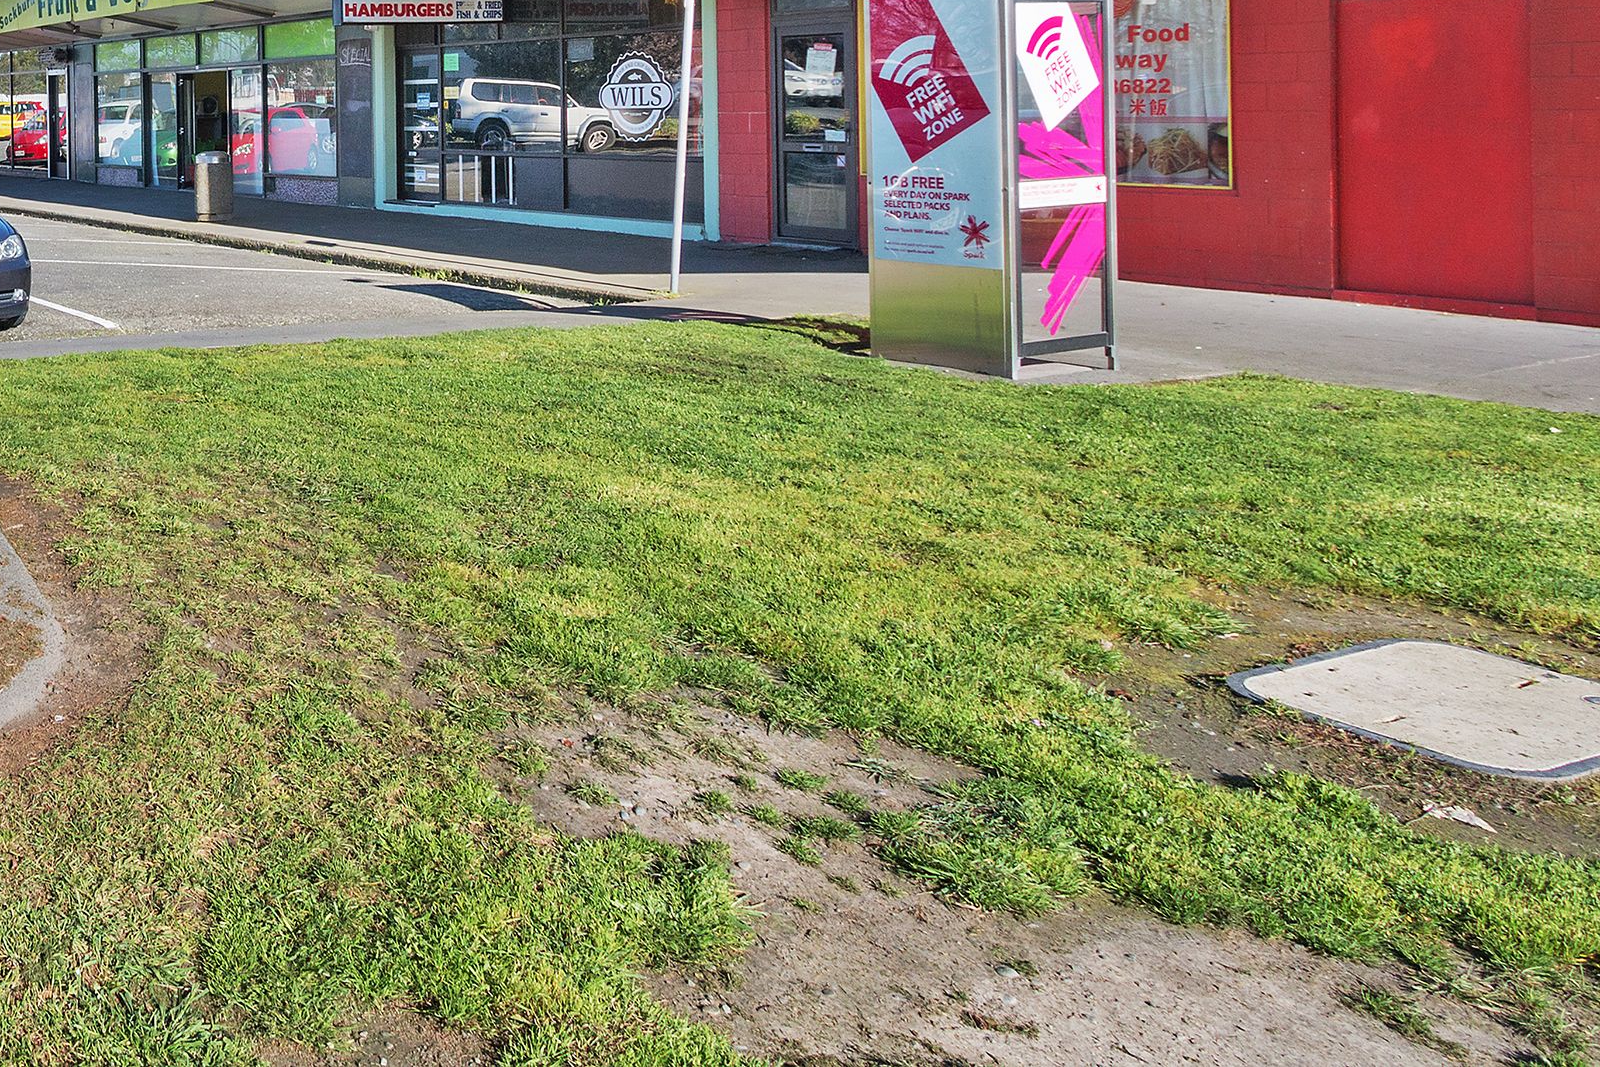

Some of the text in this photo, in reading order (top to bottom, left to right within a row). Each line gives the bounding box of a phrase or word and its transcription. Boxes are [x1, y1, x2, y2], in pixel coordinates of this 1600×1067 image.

[344, 2, 454, 17] HAMBURGERS
[456, 10, 503, 19] FISH & CHIPS
[485, 0, 502, 10] FRIED
[1127, 22, 1190, 43] Food
[1045, 50, 1072, 81] FREE
[1114, 54, 1168, 72] way
[1050, 63, 1077, 95] WiFi
[610, 85, 662, 107] WILS
[906, 73, 947, 109] FREE
[1056, 79, 1082, 109] ZONE
[913, 89, 956, 125] WiFi
[923, 107, 964, 141] ZONE
[911, 176, 944, 190] FREE
[884, 190, 970, 201] EVERY DAY ON SPARK
[884, 199, 951, 211] SELECTED PACKS
[884, 210, 932, 220] AND PLANS.
